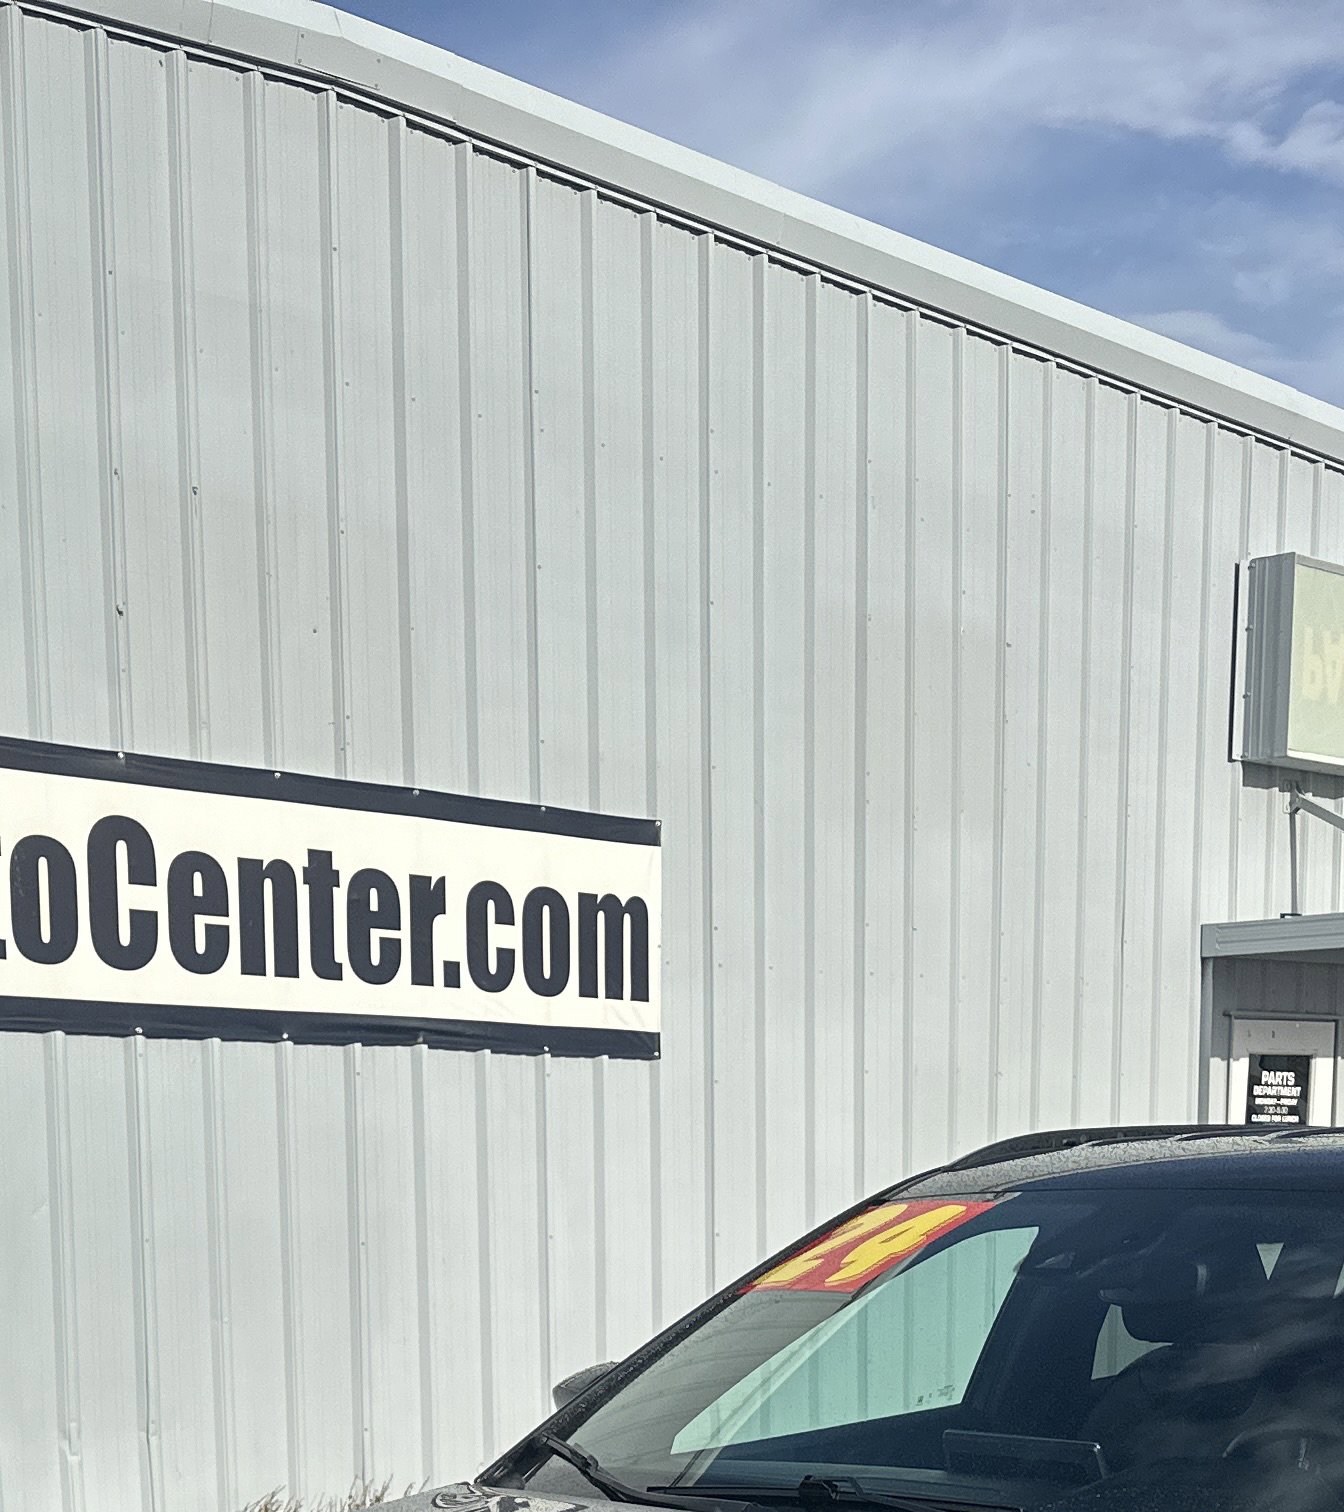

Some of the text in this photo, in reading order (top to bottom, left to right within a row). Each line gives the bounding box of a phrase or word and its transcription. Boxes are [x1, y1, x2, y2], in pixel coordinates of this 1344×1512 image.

[1262, 1071, 1295, 1085] PARTS
[1253, 1085, 1301, 1096] DEPARTMENT
[753, 1203, 967, 1286] 24
